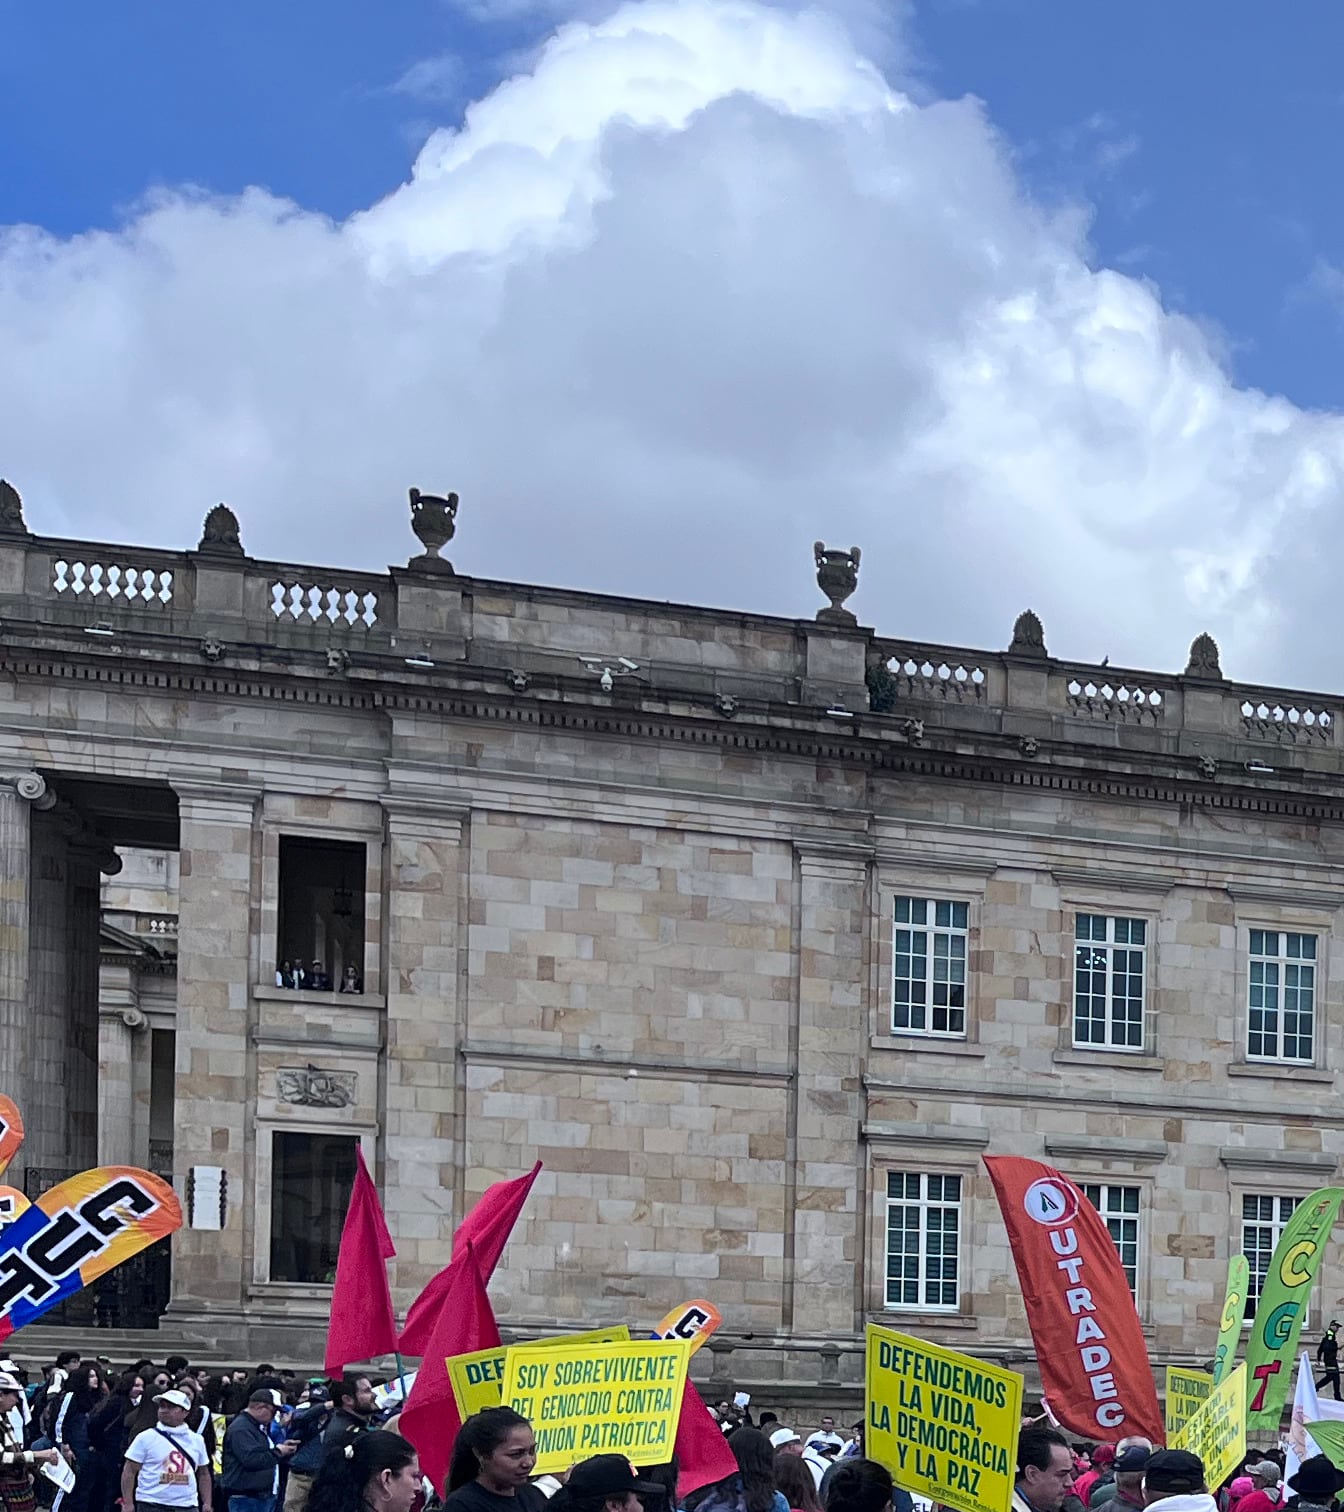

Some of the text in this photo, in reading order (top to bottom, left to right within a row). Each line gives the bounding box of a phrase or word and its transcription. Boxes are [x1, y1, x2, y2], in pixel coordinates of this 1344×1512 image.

[1049, 1227, 1125, 1428] UTRADEC
[517, 1355, 677, 1389] SOY SOBREVIVIENTE
[879, 1341, 1006, 1408] DEFENDEMOS
[541, 1390, 612, 1420] GENOCIDIO
[616, 1387, 672, 1414] CONTRA
[870, 1401, 891, 1433] LA
[899, 1379, 982, 1435] LA VIDA,
[581, 1416, 666, 1448] PATRIÓTICA
[897, 1442, 982, 1497] Y LA PAZ
